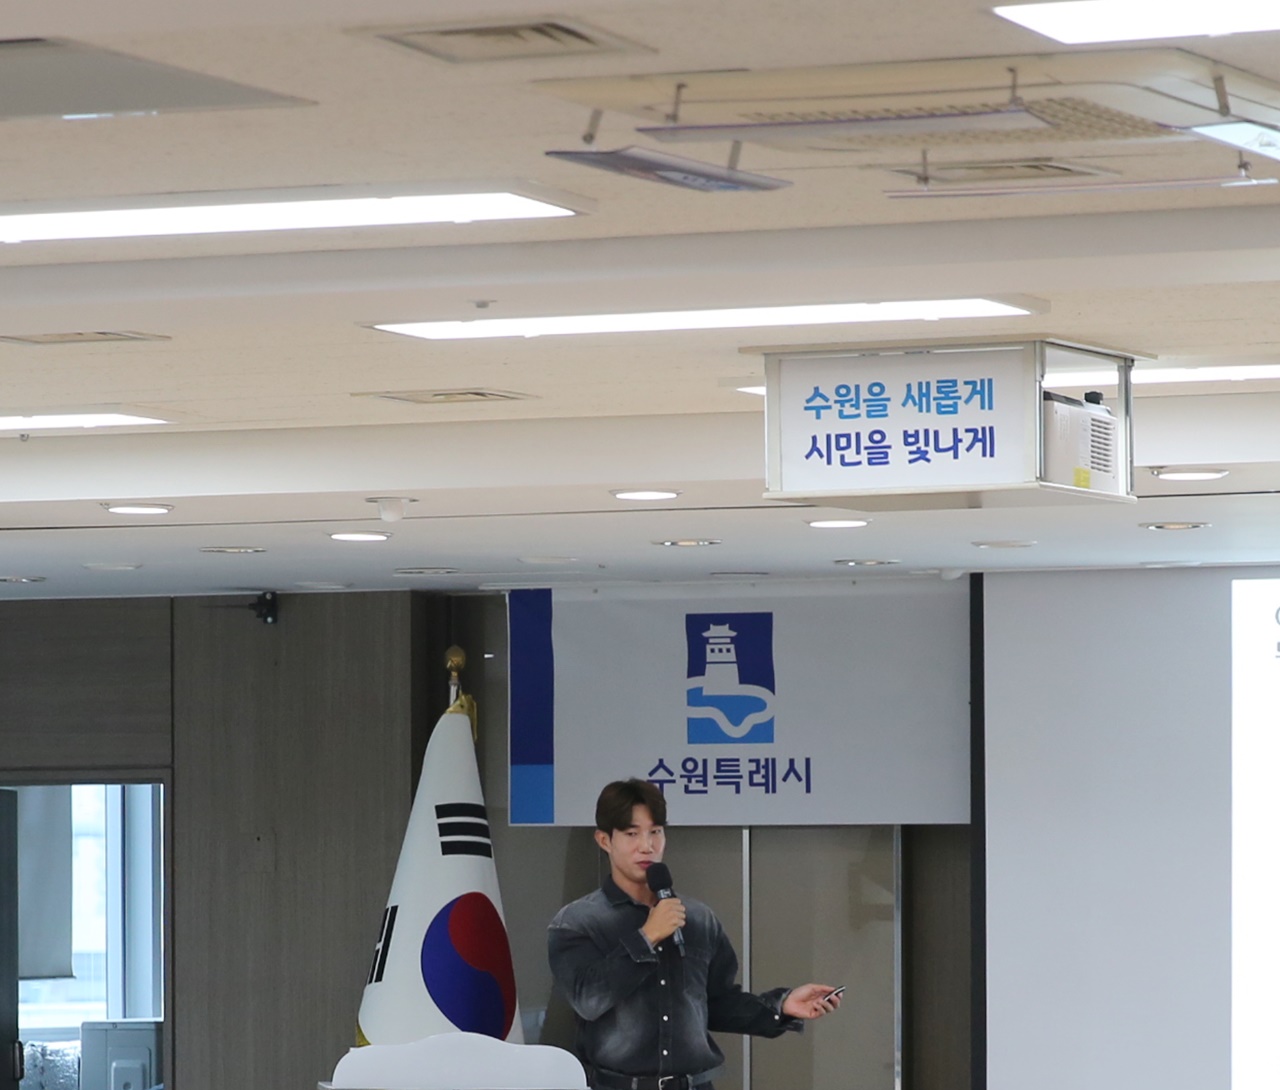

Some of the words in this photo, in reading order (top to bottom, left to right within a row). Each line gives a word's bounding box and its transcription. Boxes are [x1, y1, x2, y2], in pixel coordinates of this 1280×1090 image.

[803, 381, 891, 420] 수원을
[901, 378, 994, 415] 새롭게
[804, 429, 892, 467] 시민을
[903, 426, 995, 464] 빛나게
[648, 756, 812, 795] 수원특례시
